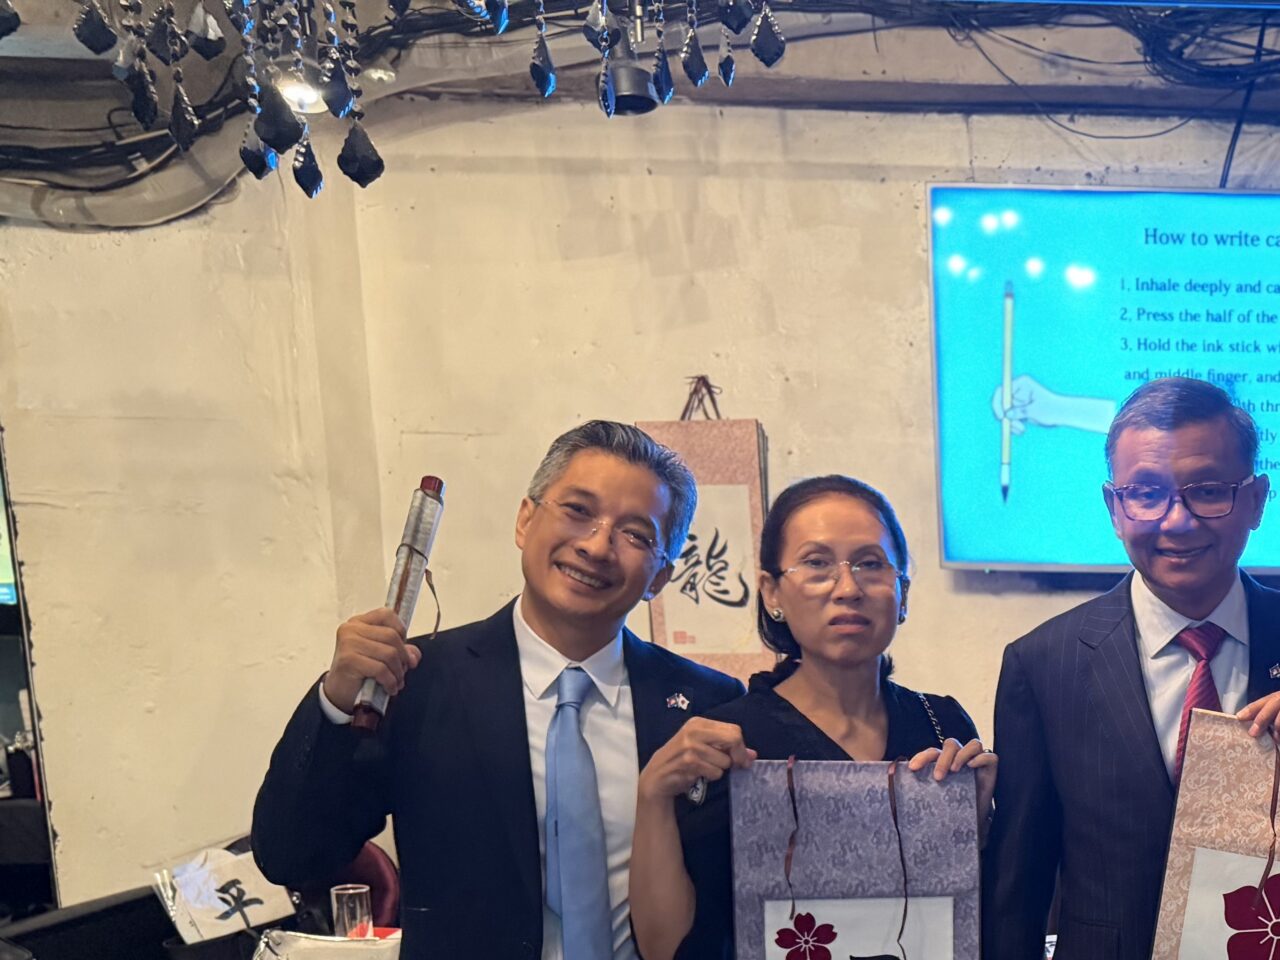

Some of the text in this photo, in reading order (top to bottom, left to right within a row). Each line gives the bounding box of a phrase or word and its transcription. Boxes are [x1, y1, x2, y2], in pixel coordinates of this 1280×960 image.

[1144, 228, 1186, 246] How
[1191, 231, 1208, 247] to
[1214, 230, 1260, 248] write
[1135, 278, 1180, 293] Inhale
[1184, 279, 1230, 297] deeply
[1235, 280, 1261, 294] and
[1136, 307, 1175, 322] Press
[1179, 309, 1200, 323] the
[1206, 309, 1235, 323] half
[1237, 309, 1255, 323] of
[1256, 310, 1278, 324] the
[1137, 337, 1171, 352] Hold
[1175, 339, 1198, 353] the
[1202, 339, 1224, 353] ink
[1229, 339, 1261, 353] stick
[1124, 368, 1149, 380] and
[1256, 370, 1280, 384] and
[1259, 457, 1280, 471] the
